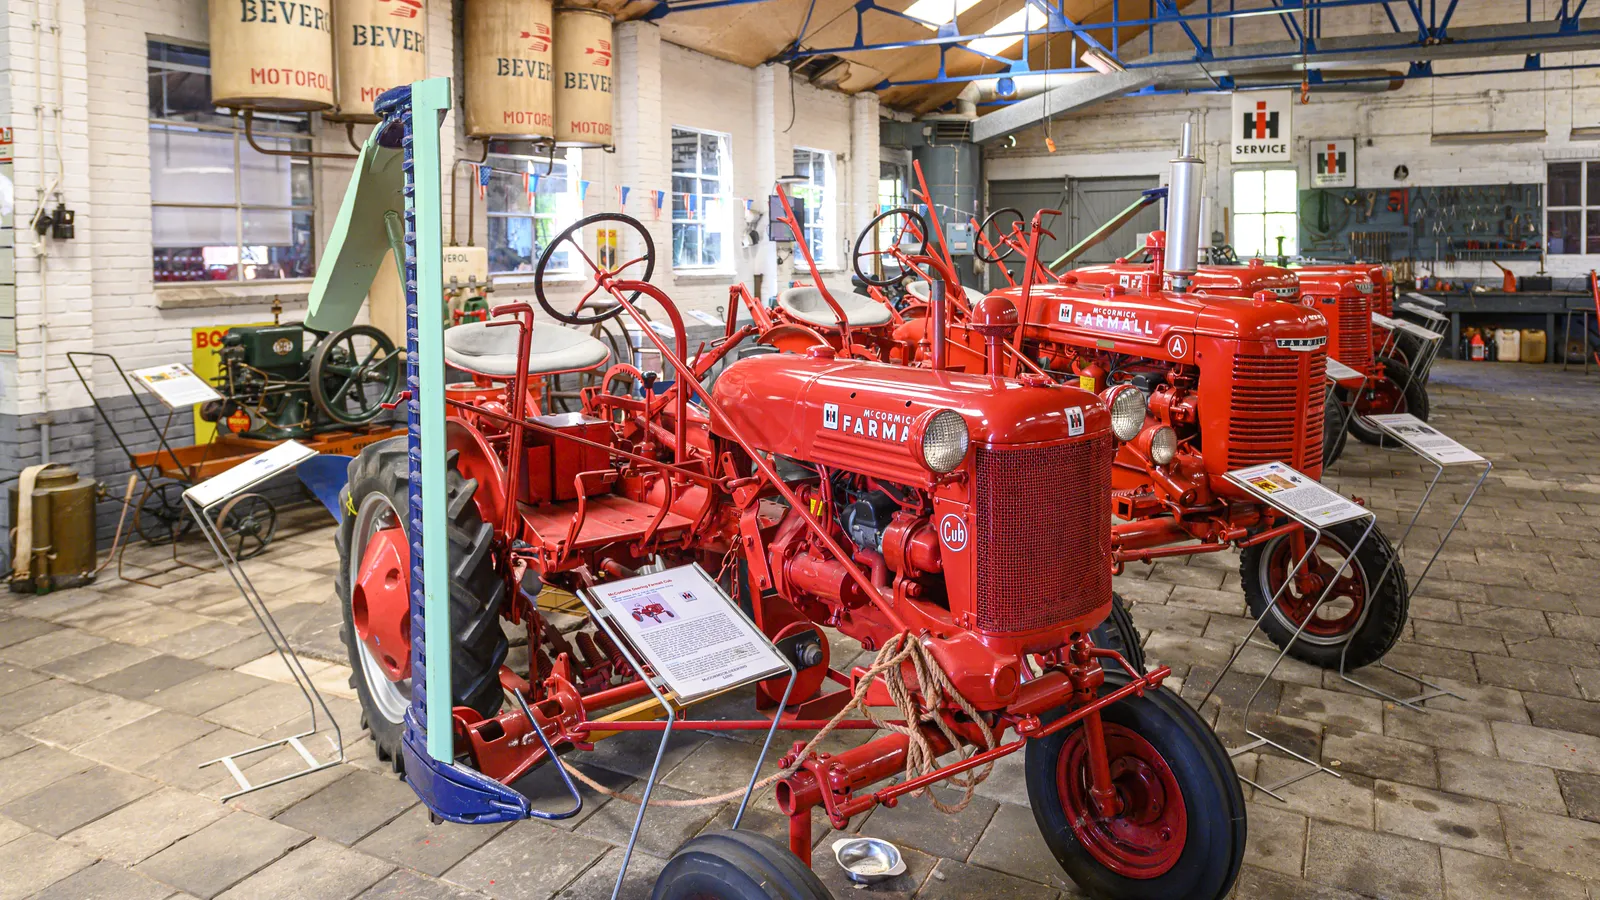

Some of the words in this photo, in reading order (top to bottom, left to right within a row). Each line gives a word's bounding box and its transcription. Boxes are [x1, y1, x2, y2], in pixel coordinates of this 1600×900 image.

[1236, 144, 1286, 154] SERVICE
[1075, 311, 1153, 335] FARMALL
[1172, 338, 1183, 354] A
[944, 521, 965, 543] Cub
